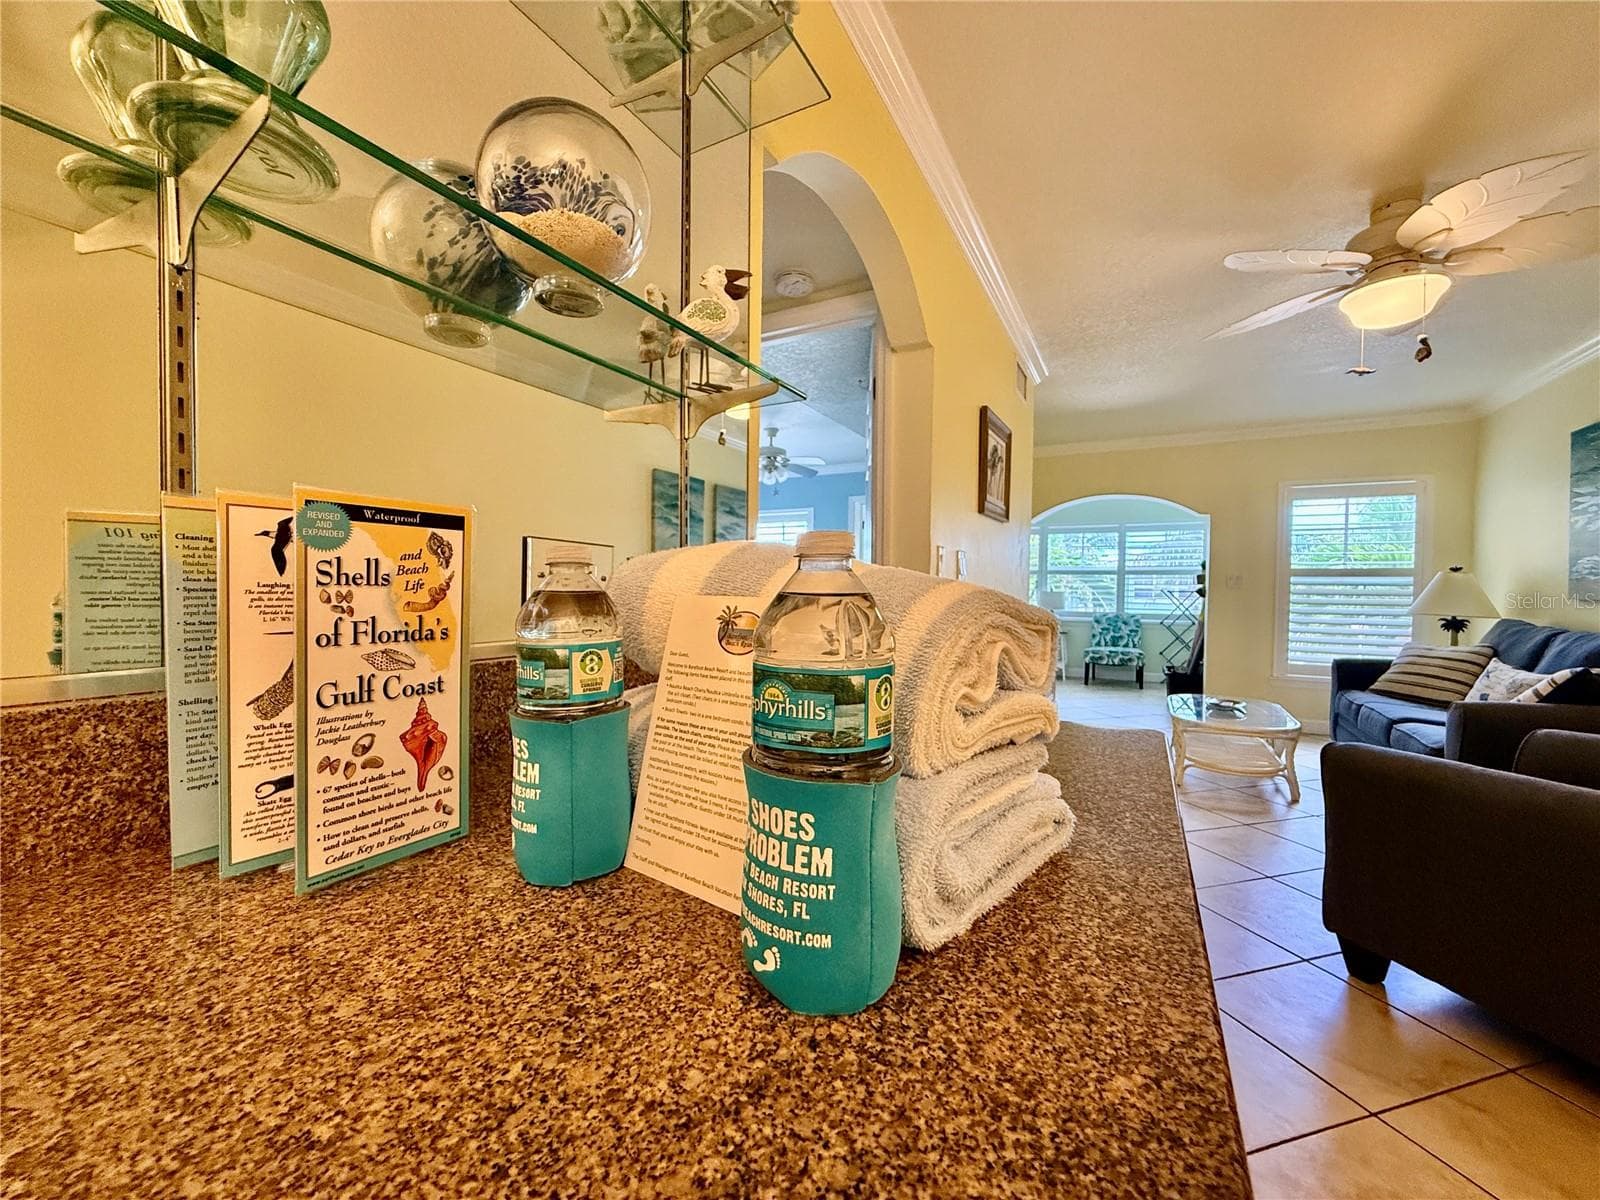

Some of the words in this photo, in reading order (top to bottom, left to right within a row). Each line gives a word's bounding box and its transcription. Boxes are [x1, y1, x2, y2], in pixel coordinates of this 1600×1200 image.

[307, 510, 340, 521] REVISED
[363, 509, 421, 524] Waterproof
[315, 520, 333, 529] AND
[175, 533, 215, 543] Cleaning
[302, 528, 345, 539] EXPANDED
[400, 549, 422, 561] and
[315, 556, 391, 588] Shells
[396, 562, 429, 576] Beach
[257, 581, 291, 589] Laughing
[404, 579, 425, 595] Life
[315, 617, 343, 648] of
[350, 615, 449, 646] Florida's
[316, 673, 376, 709] Gulf
[383, 674, 445, 700] Coast
[178, 697, 214, 706] Shelling
[316, 713, 363, 725] Illustrations
[365, 710, 374, 720] by
[314, 726, 340, 738] Jackie
[322, 786, 332, 794] 67
[334, 781, 358, 792] species
[323, 792, 355, 805] common
[356, 786, 369, 796] and
[323, 802, 345, 814] found
[357, 794, 382, 804] beaches
[384, 788, 396, 798] and
[397, 786, 411, 794] bays
[323, 814, 357, 828] Common
[358, 808, 377, 818] shore
[378, 802, 394, 812] birds
[395, 798, 407, 807] and
[409, 795, 424, 803] other
[426, 789, 443, 799] beach
[323, 832, 341, 842] How
[352, 824, 370, 833] clean
[371, 817, 383, 828] and
[384, 812, 410, 825] preserve
[751, 797, 816, 842] SHOES
[323, 840, 340, 851] sand
[368, 827, 381, 838] and
[382, 821, 405, 833] starfish
[325, 851, 355, 865] Cedar
[357, 844, 375, 856] Key
[388, 825, 431, 844] Everglades
[433, 820, 449, 830] City
[750, 862, 779, 892] BEACH
[783, 879, 837, 901] RESORT
[747, 882, 788, 919] SHORES,
[792, 901, 810, 920] FL
